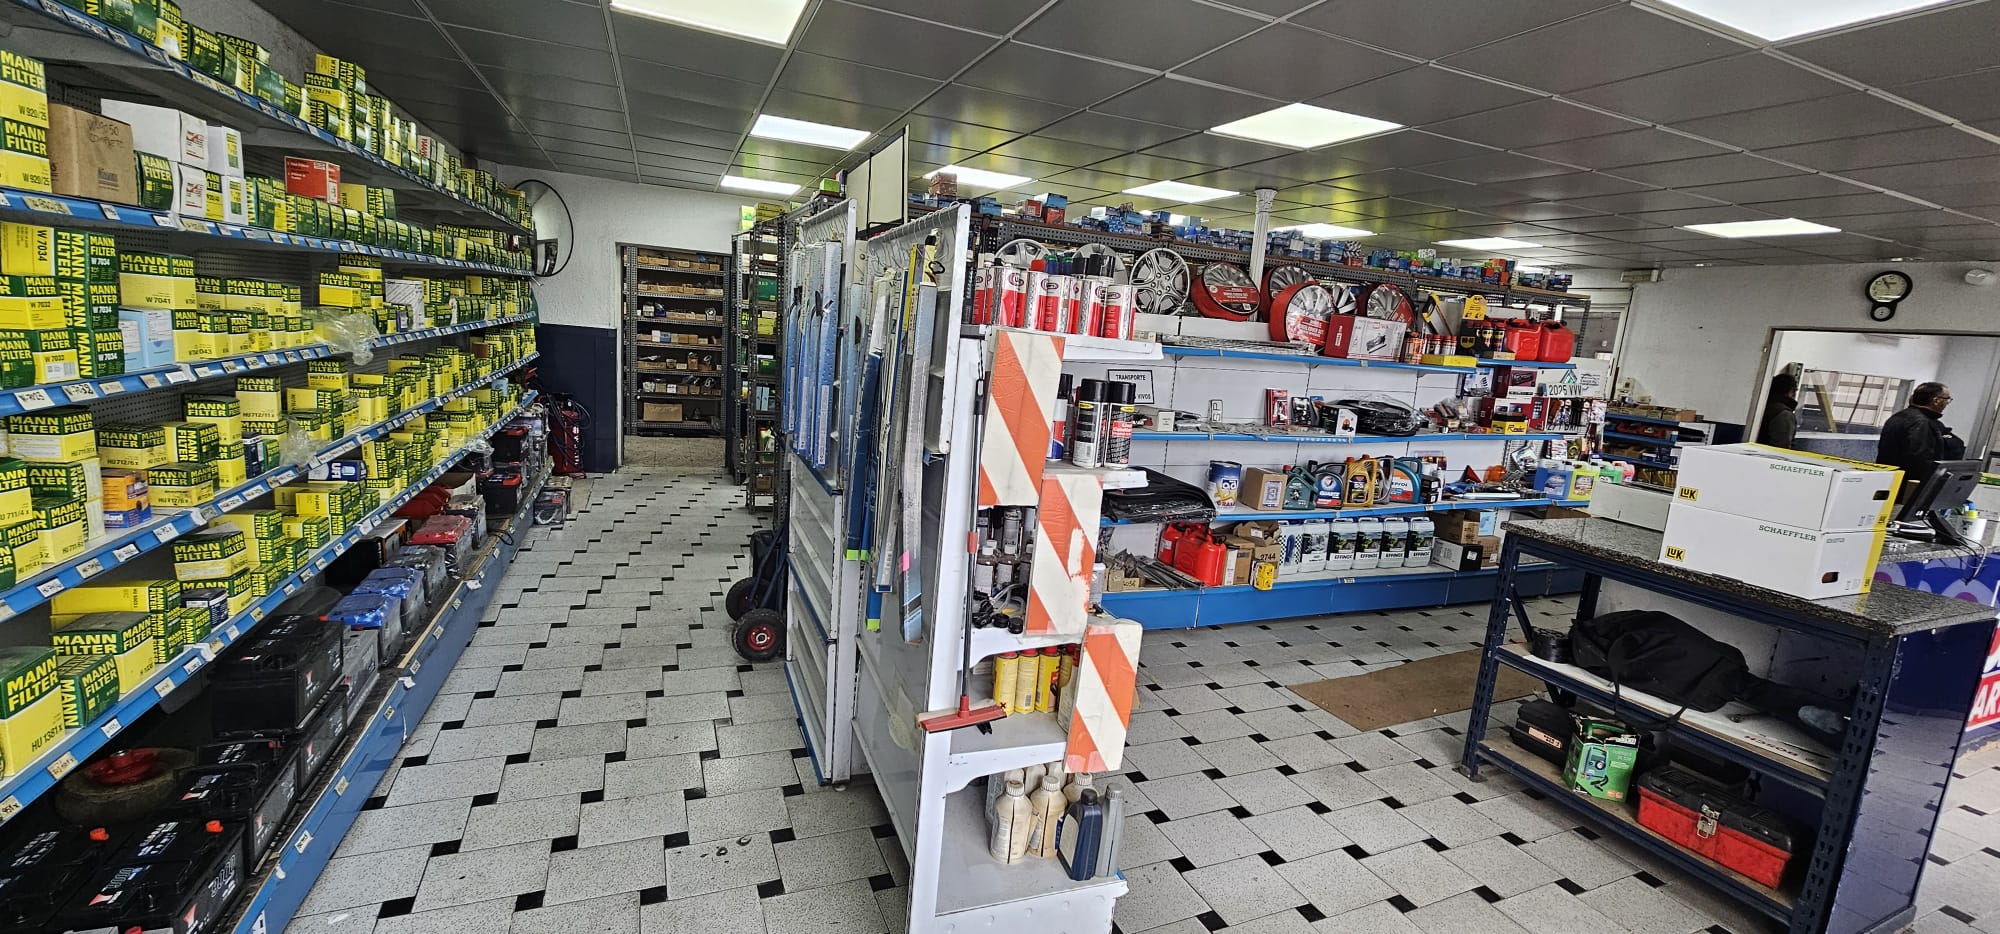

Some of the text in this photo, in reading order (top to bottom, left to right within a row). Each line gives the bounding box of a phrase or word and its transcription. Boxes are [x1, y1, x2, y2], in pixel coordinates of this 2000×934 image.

[193, 28, 220, 45] MANN
[194, 36, 220, 54] FILTER
[1, 50, 43, 77] MANN
[2, 64, 45, 90] FILTER
[5, 120, 46, 142] MANN
[7, 132, 47, 155] FILTER
[141, 154, 169, 169] MANN
[144, 165, 173, 181] FILTER
[37, 230, 48, 262] W 7034
[90, 235, 115, 247] MANN
[57, 231, 71, 276] FILTER
[71, 233, 85, 278] MANN
[90, 246, 116, 257] FILTER
[120, 254, 169, 267] MANN
[172, 258, 194, 268] MANN
[121, 262, 169, 275] FILTER
[173, 266, 195, 276] FILTER
[26, 277, 55, 287] MANN
[320, 272, 350, 280] MANN
[227, 280, 265, 290] MANN
[321, 278, 351, 288] FILTER
[27, 286, 57, 296] FILTER
[90, 285, 116, 295] MANN
[227, 287, 266, 296] FILTER
[59, 281, 73, 328] FILTER
[91, 294, 118, 304] FILTER
[71, 283, 87, 328] MANN
[176, 311, 197, 320] MANN
[176, 319, 199, 329] FILTER
[40, 331, 69, 342] MANN
[94, 332, 122, 343] MANN
[0, 340, 30, 352] MANN
[41, 340, 71, 351] FILTER
[96, 342, 124, 353] FILTER
[0, 350, 33, 361] FILTER
[77, 332, 94, 376] MANN
[239, 377, 274, 386] MANN
[237, 384, 274, 392] FILTER
[1548, 385, 1567, 397] 2025
[187, 402, 226, 411] MANN
[9, 414, 59, 426] MANN
[63, 412, 93, 425] MANN
[188, 410, 226, 418] FILTER
[10, 423, 60, 434] FILTER
[64, 420, 94, 434] FILTER
[99, 431, 138, 441] MANN
[99, 439, 139, 448] FILTER
[178, 430, 189, 461] FILTER
[187, 430, 198, 462] MANN
[0, 468, 27, 482] ANN
[29, 468, 68, 478] ANN
[149, 470, 187, 479] MANN
[1769, 463, 1826, 477] SCHAEFFLER
[0, 478, 29, 491] LTER
[31, 476, 68, 486] LTER
[149, 478, 188, 487] FILTER
[51, 502, 80, 518] MANN
[52, 509, 82, 528] FILTER
[7, 519, 38, 539] MANN
[1758, 524, 1818, 542] SCHAEFFLER
[10, 530, 39, 547] FILTER
[174, 543, 221, 554] MANN
[175, 550, 223, 562] FILTER
[181, 581, 228, 590] MANN
[123, 616, 152, 640] MANN
[52, 635, 117, 646] MANN
[124, 629, 153, 652] FILTER
[55, 644, 118, 656] FILTER
[7, 655, 58, 697] MANN
[82, 658, 116, 687] MANN
[85, 670, 118, 698] FILTER
[9, 670, 59, 713] FILTER
[61, 680, 80, 727] MANN
[31, 737, 43, 752] HU
